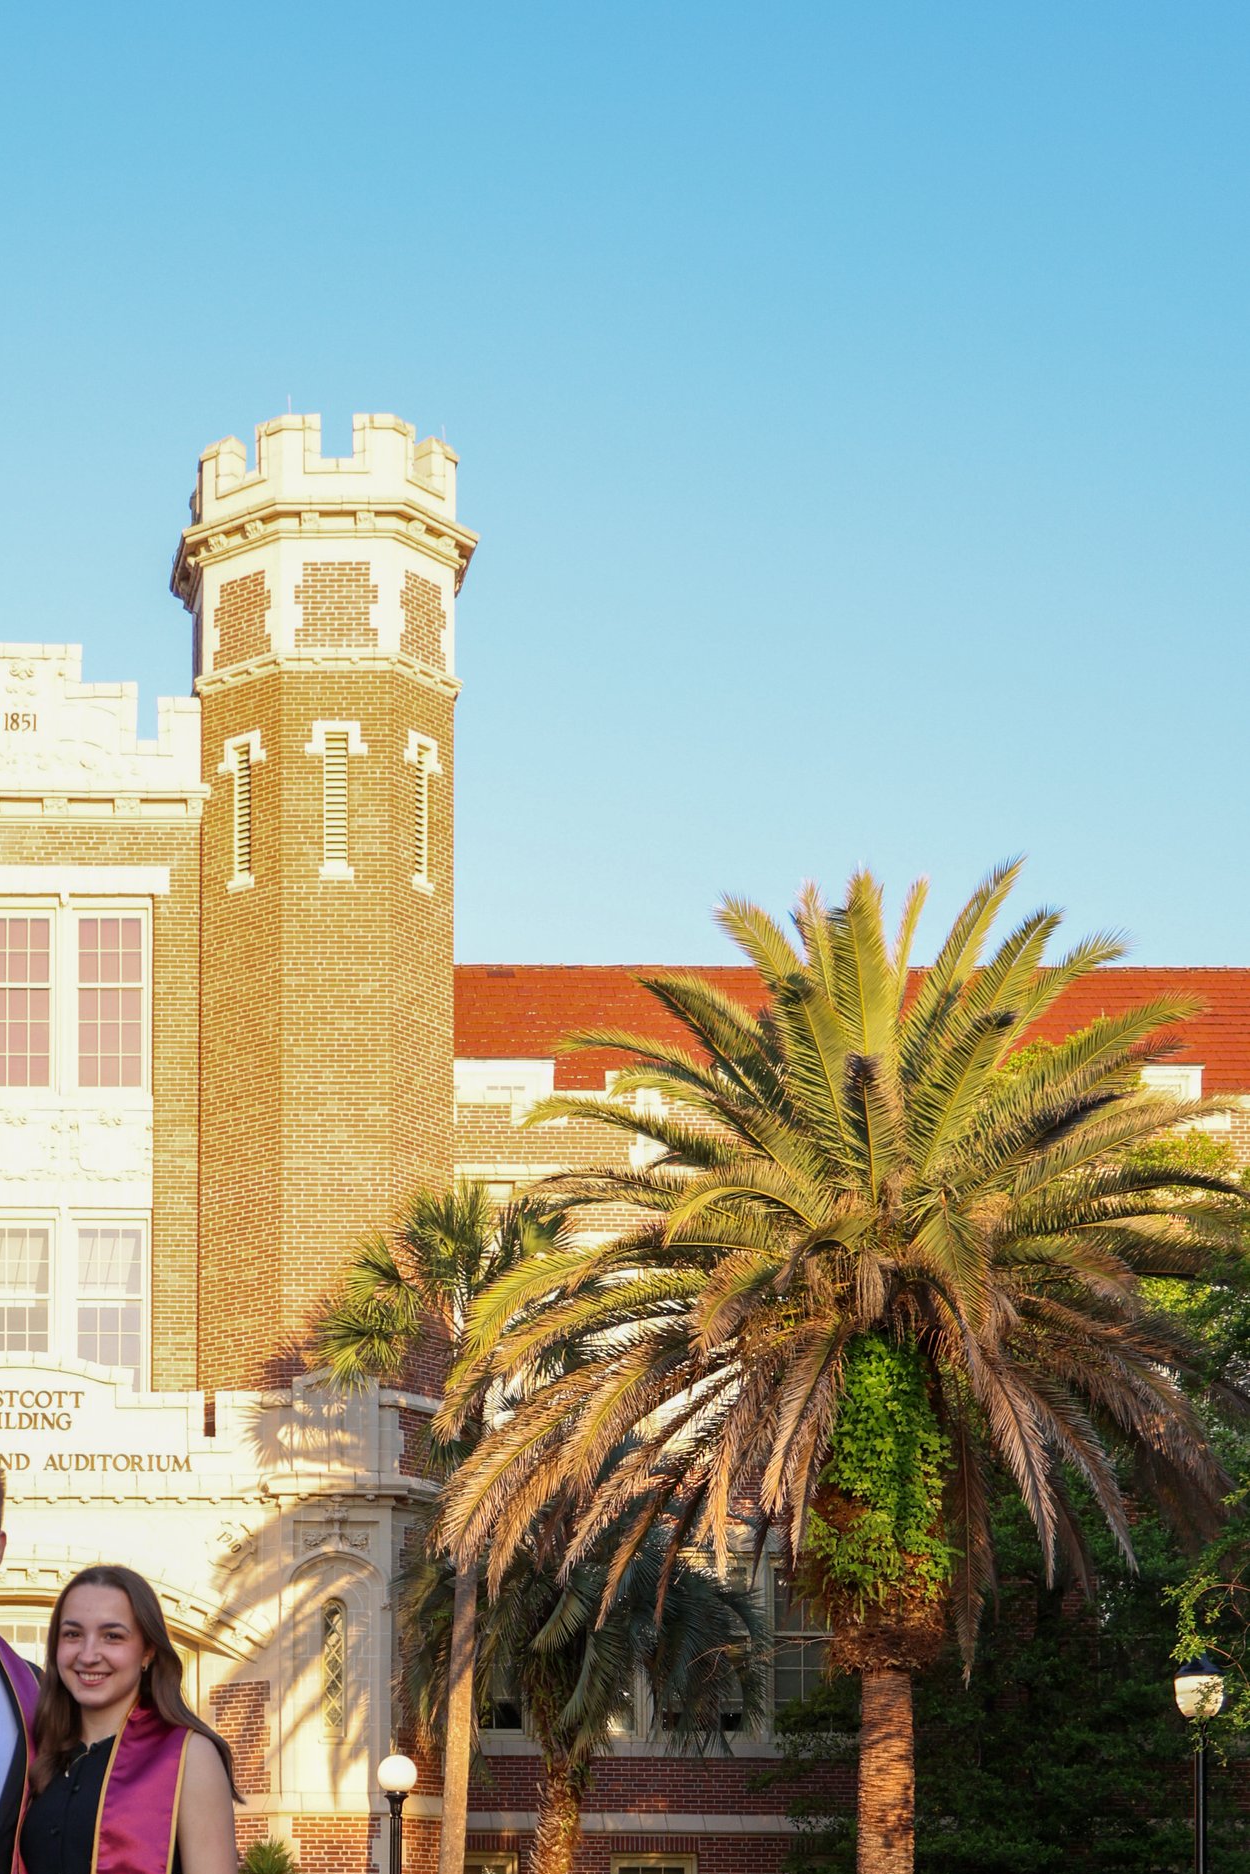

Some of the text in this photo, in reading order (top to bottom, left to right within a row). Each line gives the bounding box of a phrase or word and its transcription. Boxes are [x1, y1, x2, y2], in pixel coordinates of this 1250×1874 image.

[4, 713, 37, 731] 1851
[44, 1452, 192, 1472] AUDITORIUM
[217, 1531, 241, 1553] 1910
